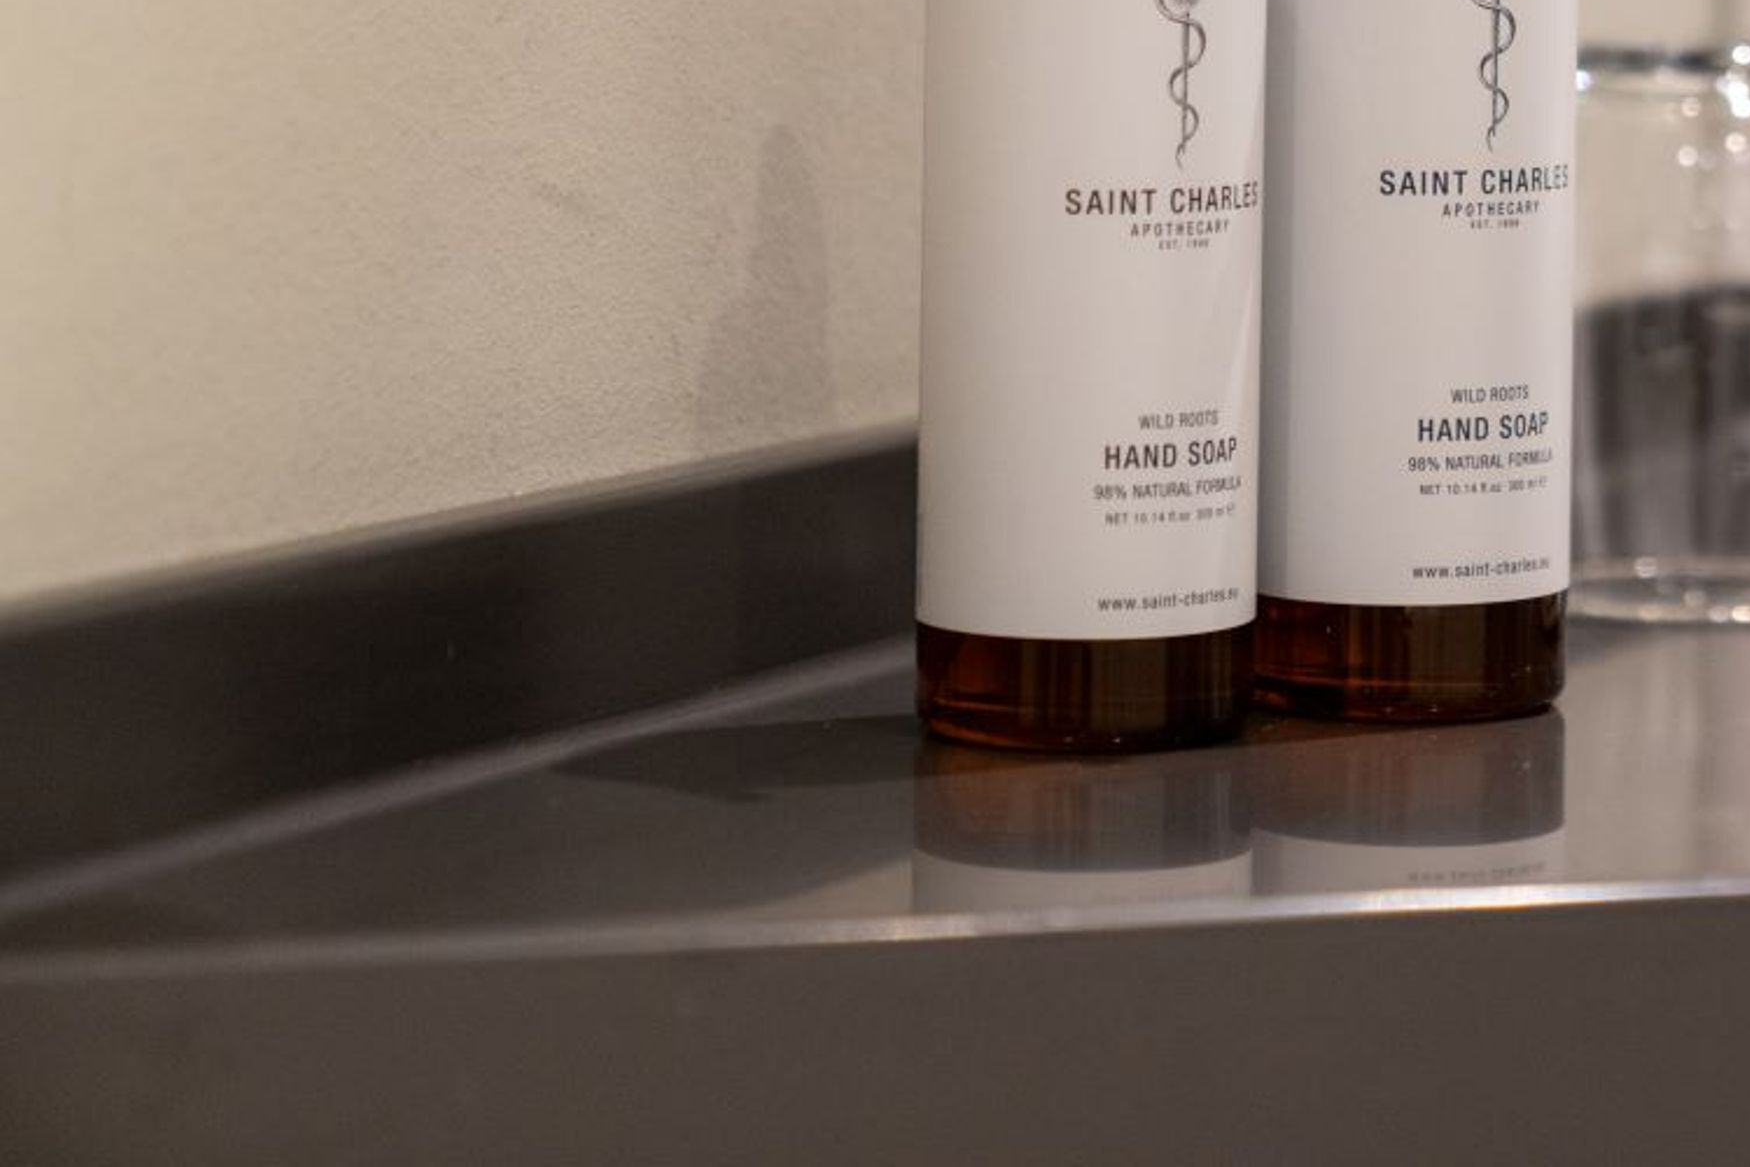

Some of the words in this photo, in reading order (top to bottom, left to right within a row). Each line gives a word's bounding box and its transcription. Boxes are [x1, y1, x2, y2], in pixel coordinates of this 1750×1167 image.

[1380, 169, 1468, 196] SAINT
[1481, 164, 1568, 195] CHARLES
[1065, 188, 1157, 215] SAINT
[1170, 181, 1258, 214] CHARLES
[1442, 200, 1540, 217] APOTHECARY
[1131, 218, 1230, 237] APOTHECARY
[1452, 386, 1487, 403] WILD
[1490, 383, 1529, 402] ROOTS
[1138, 412, 1174, 430] WILD
[1179, 409, 1218, 427] ROOTS
[1417, 417, 1489, 443] HAND
[1499, 411, 1549, 440] SOAP
[1104, 443, 1178, 470] HAND
[1188, 435, 1237, 467] SOAP
[1408, 456, 1441, 473] 98%
[1445, 454, 1503, 471] NATURAL
[1094, 483, 1127, 500] 98%
[1133, 480, 1192, 499] NATURAL
